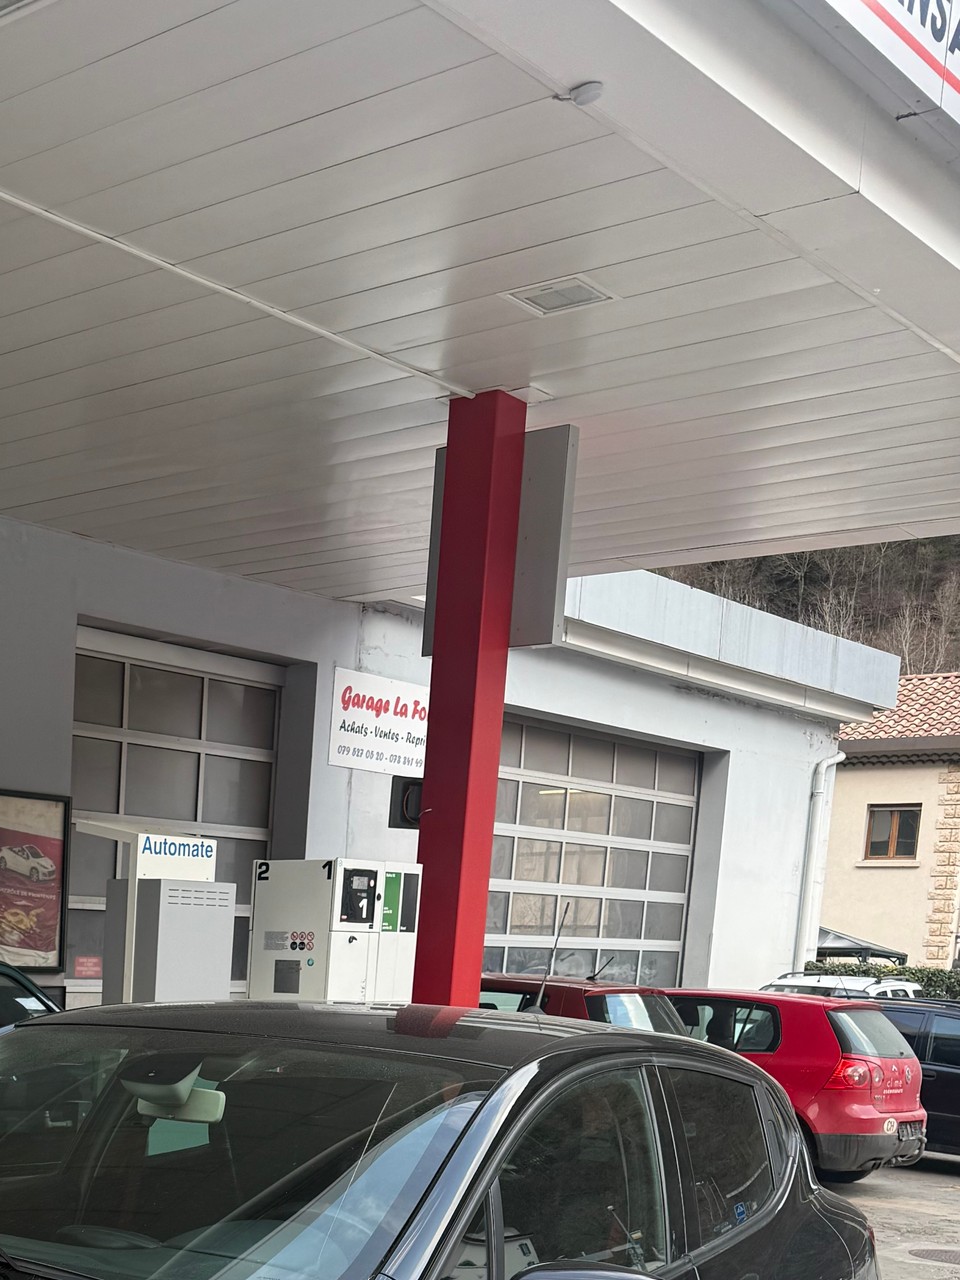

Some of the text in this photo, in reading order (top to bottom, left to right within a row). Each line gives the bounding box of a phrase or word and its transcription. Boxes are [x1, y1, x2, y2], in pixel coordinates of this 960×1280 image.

[341, 685, 428, 722] Garage La Fo
[339, 719, 369, 737] Achats
[374, 725, 400, 743] Ventes
[405, 732, 426, 748] Repri
[141, 835, 214, 860] Automate
[257, 861, 270, 881] 2
[321, 860, 333, 881] 1
[358, 898, 368, 919] 1
[886, 1119, 895, 1132] CH
